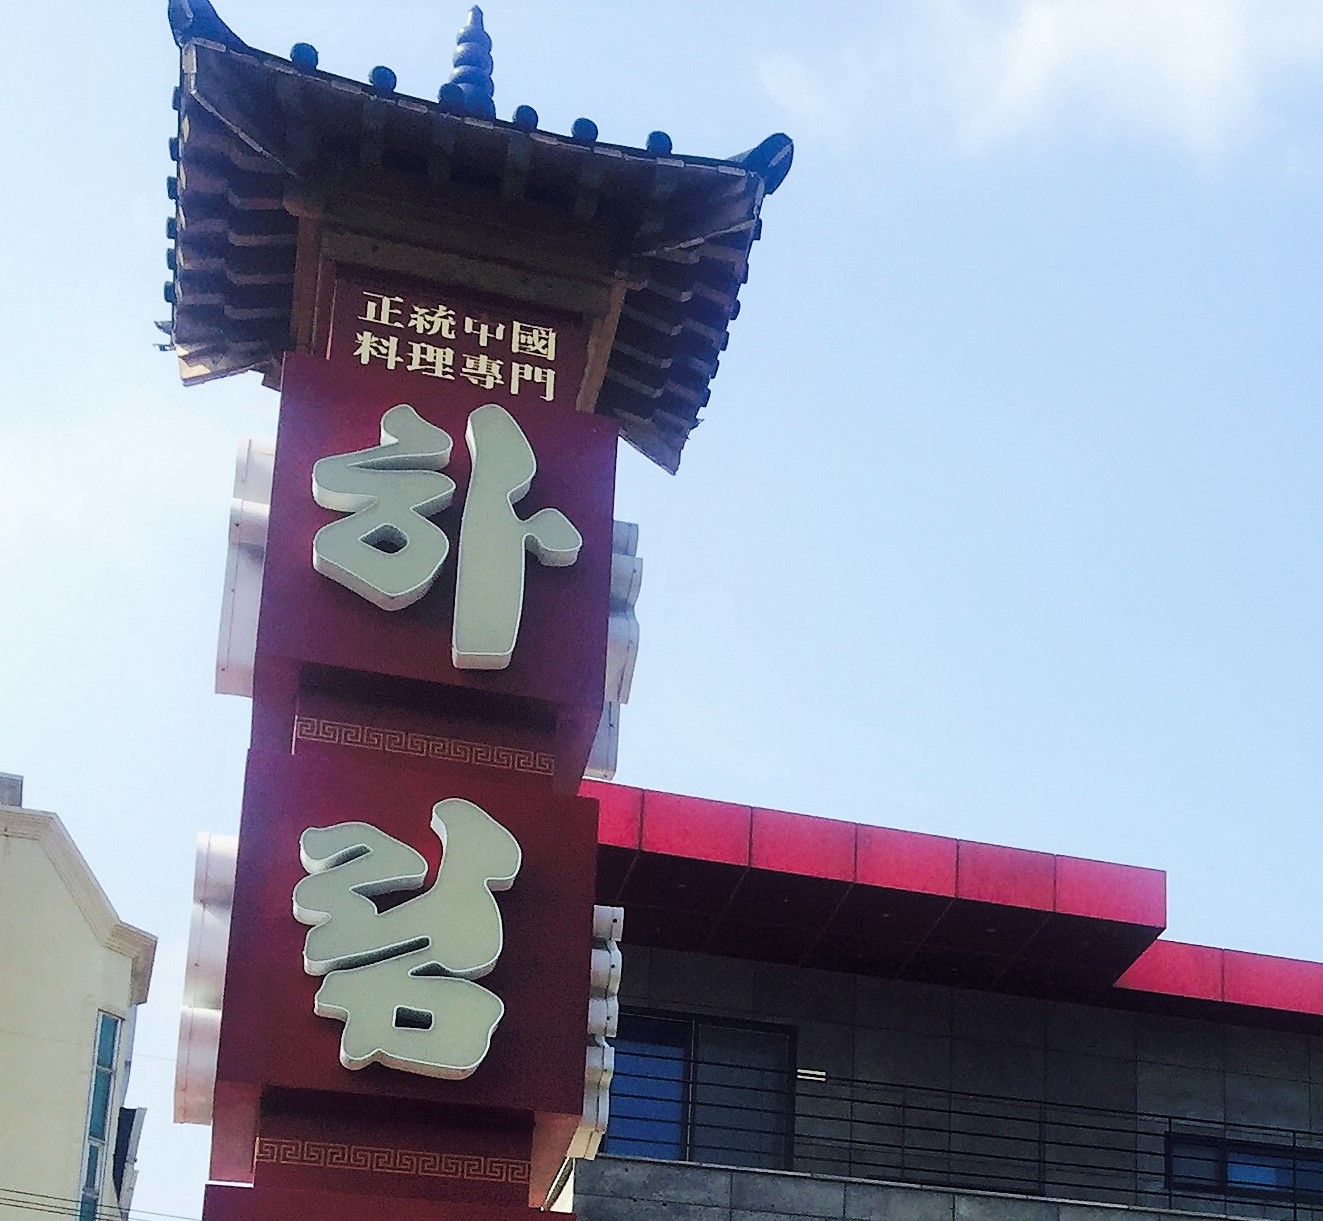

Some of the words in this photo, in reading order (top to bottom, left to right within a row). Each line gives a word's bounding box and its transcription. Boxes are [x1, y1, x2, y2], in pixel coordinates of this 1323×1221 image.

[357, 290, 557, 361] 正統中國
[352, 331, 557, 402] 料理專門
